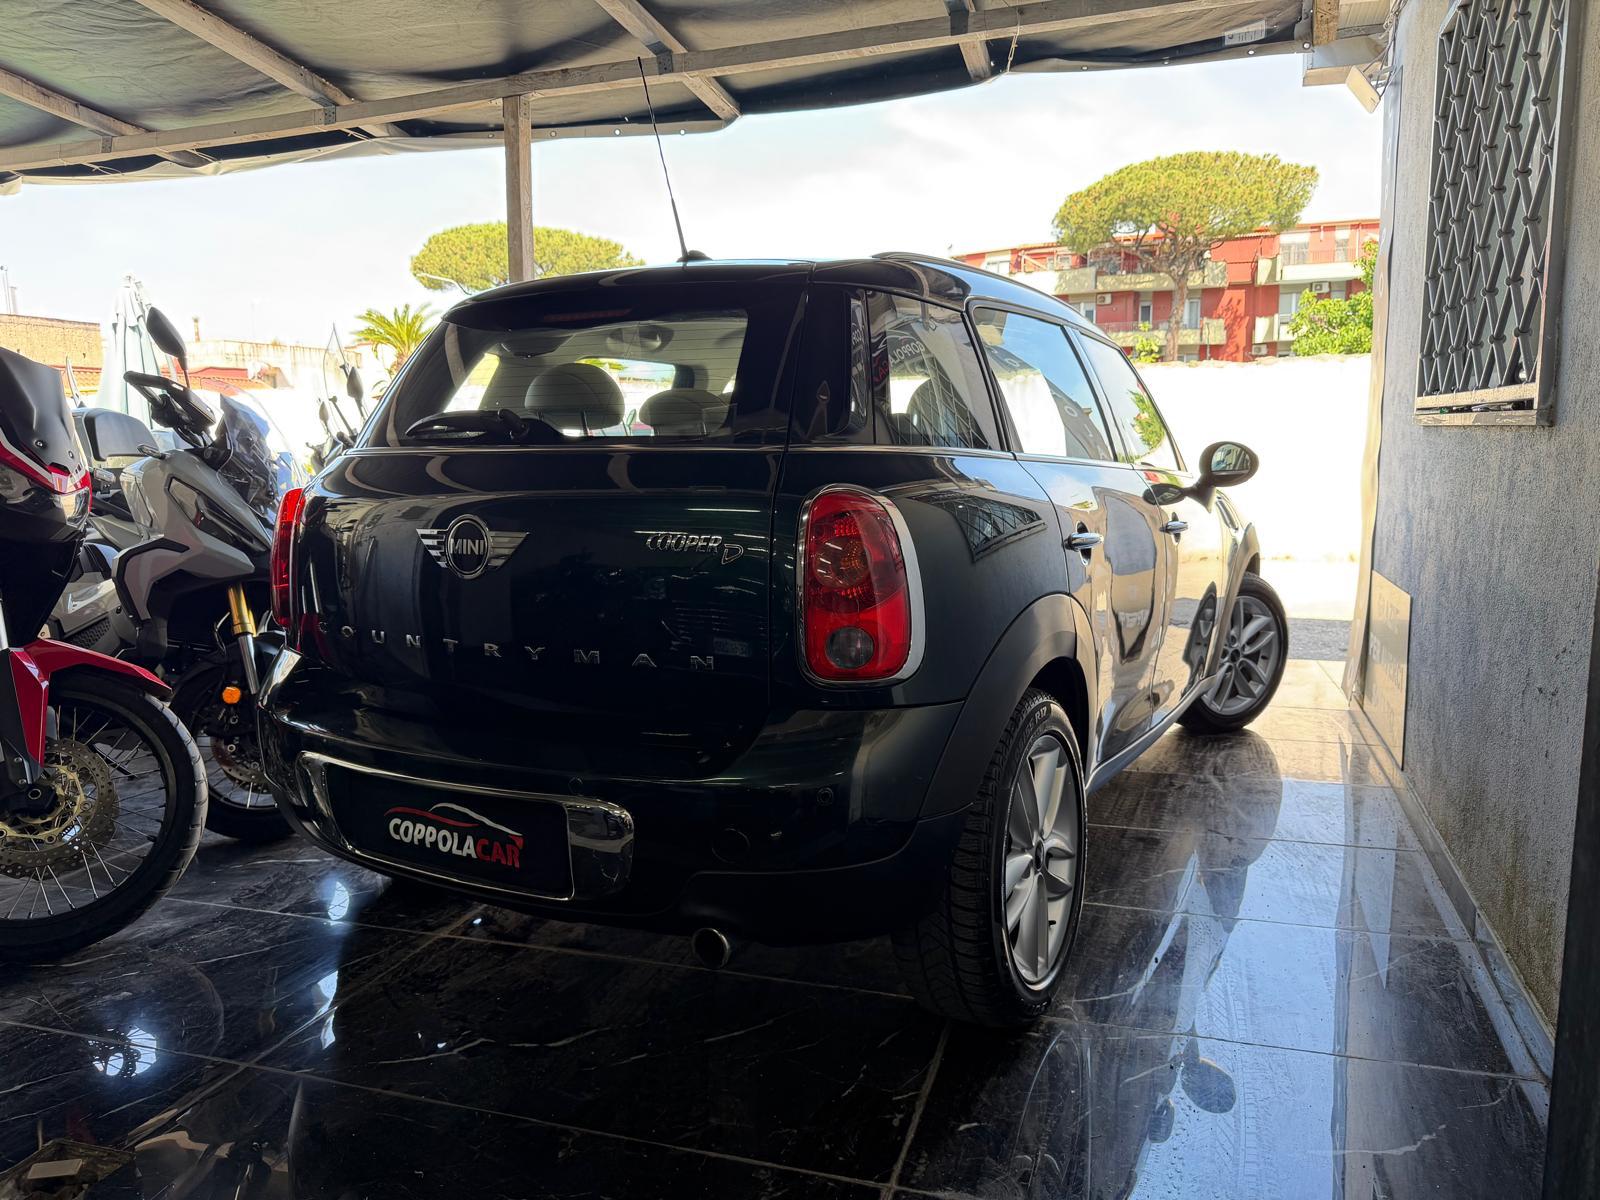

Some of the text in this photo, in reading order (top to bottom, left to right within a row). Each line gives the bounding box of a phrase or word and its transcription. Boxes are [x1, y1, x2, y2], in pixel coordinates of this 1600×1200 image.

[449, 538, 486, 555] MINI
[645, 533, 744, 565] COOPER D
[388, 816, 521, 869] COPPOLACAR
